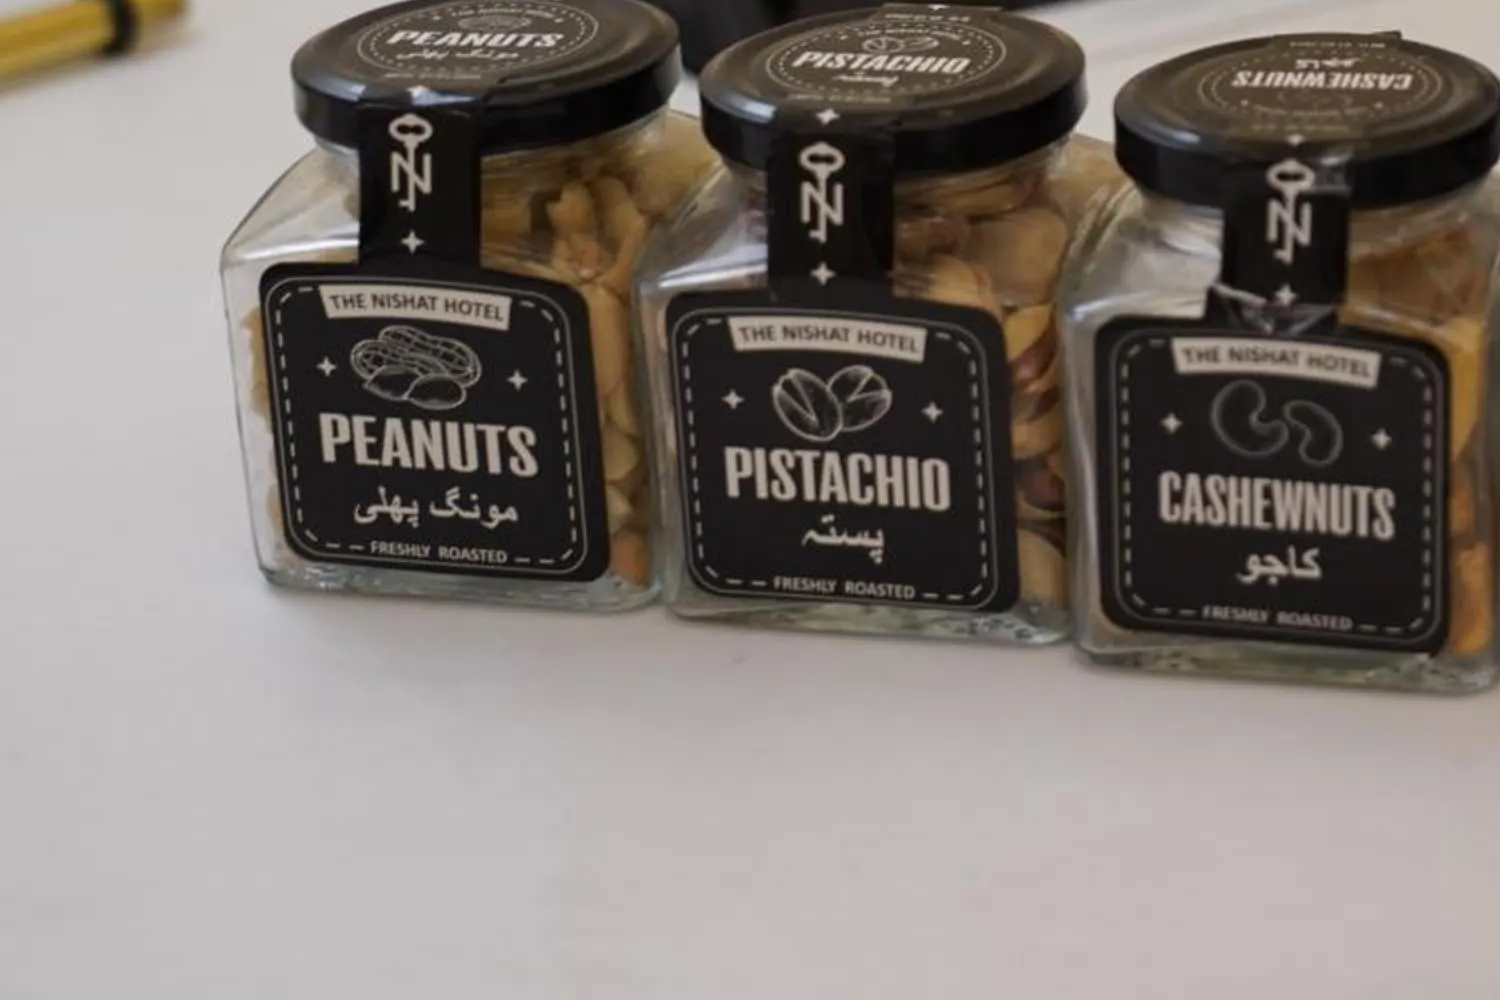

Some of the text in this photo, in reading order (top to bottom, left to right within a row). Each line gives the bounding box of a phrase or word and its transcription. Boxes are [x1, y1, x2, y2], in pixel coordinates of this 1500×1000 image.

[386, 29, 565, 48] PEANUTS
[791, 50, 972, 75] PISTACHIO
[1231, 70, 1414, 91] CASHEWNUTS
[329, 293, 504, 323] THE NISHAT HOTEL
[738, 325, 918, 353] THE NISHAT HOTEL
[1182, 346, 1371, 379] THE NISHAT HOTEL
[319, 412, 539, 478] PEANUTS
[724, 446, 952, 512] PISTACHIO
[429, 486, 518, 530] مونگ
[1158, 470, 1396, 541] CASHEWNUTS
[369, 540, 508, 564] FRESHLY ROASTED
[773, 575, 915, 600] FRESHLY ROASTED
[1202, 604, 1353, 631] FRESHLY ROASTED
